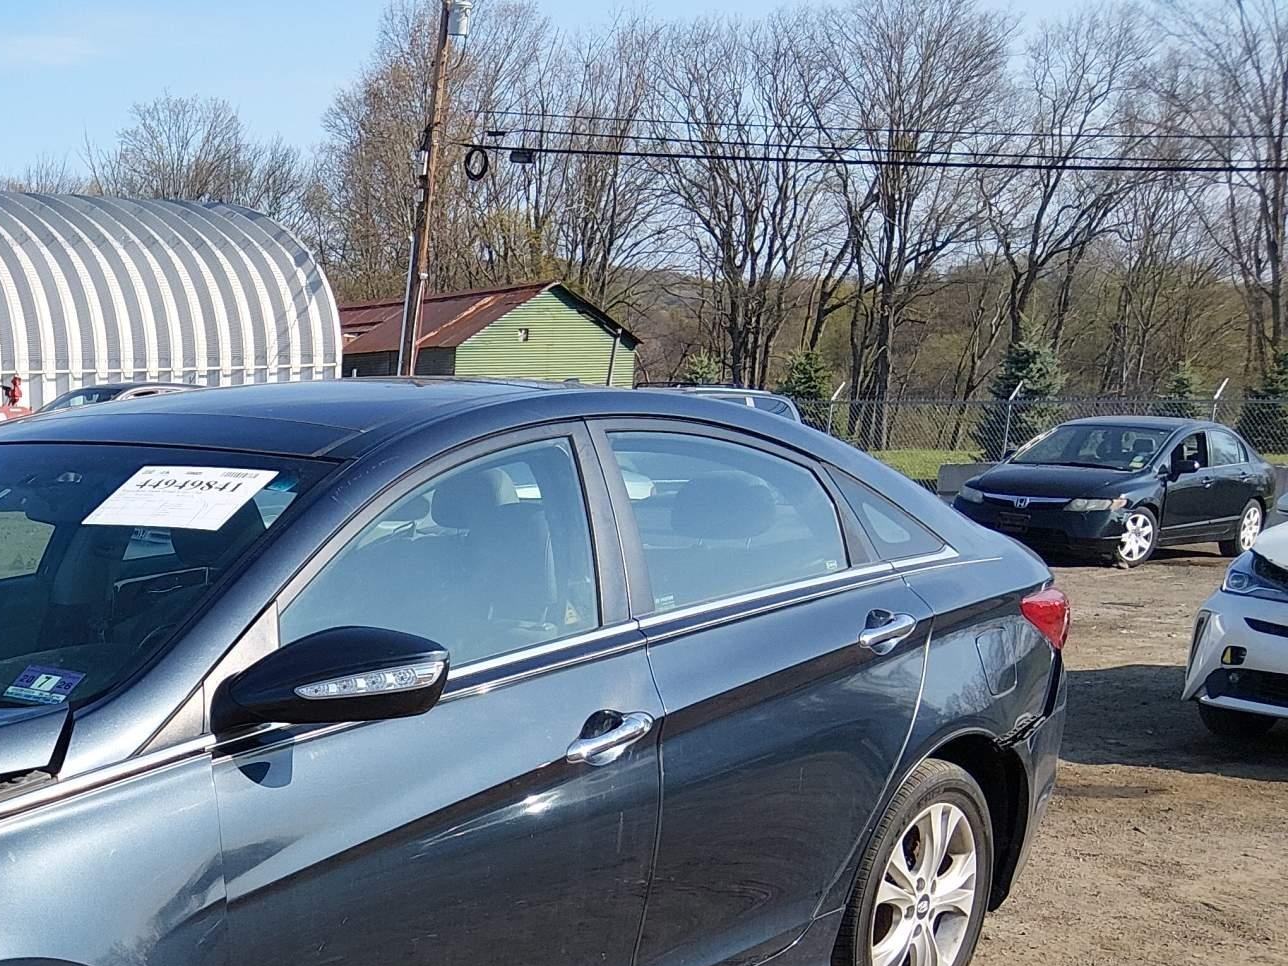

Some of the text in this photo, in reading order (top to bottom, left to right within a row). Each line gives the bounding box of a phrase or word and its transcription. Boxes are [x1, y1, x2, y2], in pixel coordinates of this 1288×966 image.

[136, 478, 243, 493] 44949841
[19, 674, 36, 683] 20
[38, 675, 53, 688] 7
[55, 681, 74, 690] 26
